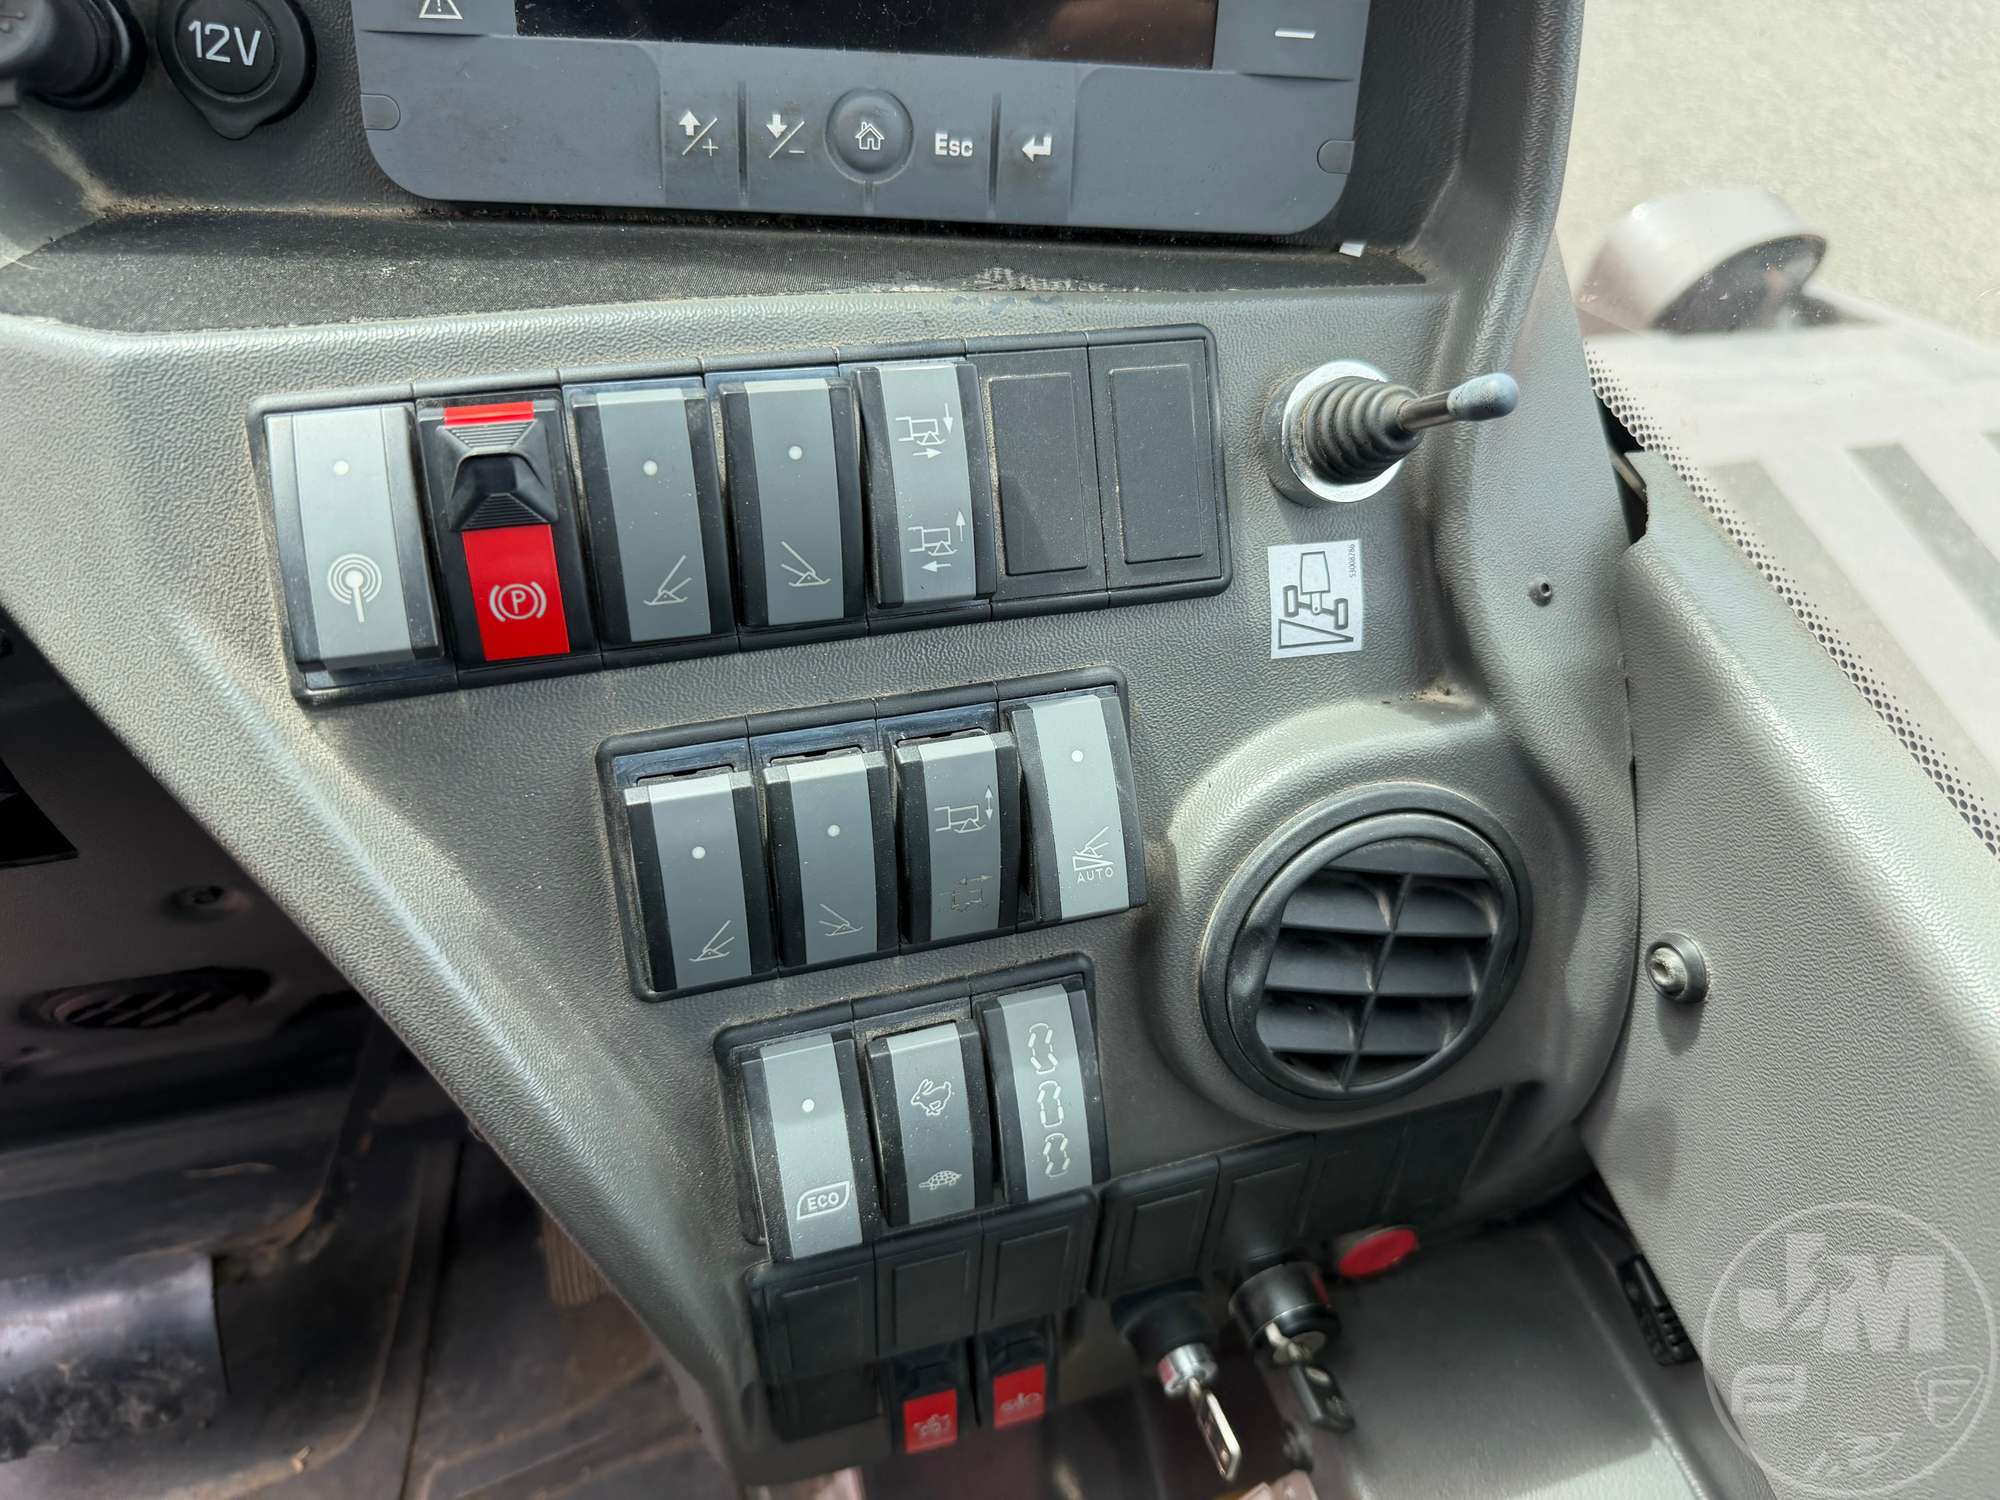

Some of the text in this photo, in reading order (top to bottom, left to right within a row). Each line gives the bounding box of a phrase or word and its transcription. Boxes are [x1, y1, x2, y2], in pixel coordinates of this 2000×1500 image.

[188, 20, 261, 66] 12V
[935, 133, 973, 157] Esc
[510, 589, 527, 614] P
[1077, 866, 1114, 884] AUTO
[807, 1192, 839, 1211] ECO
